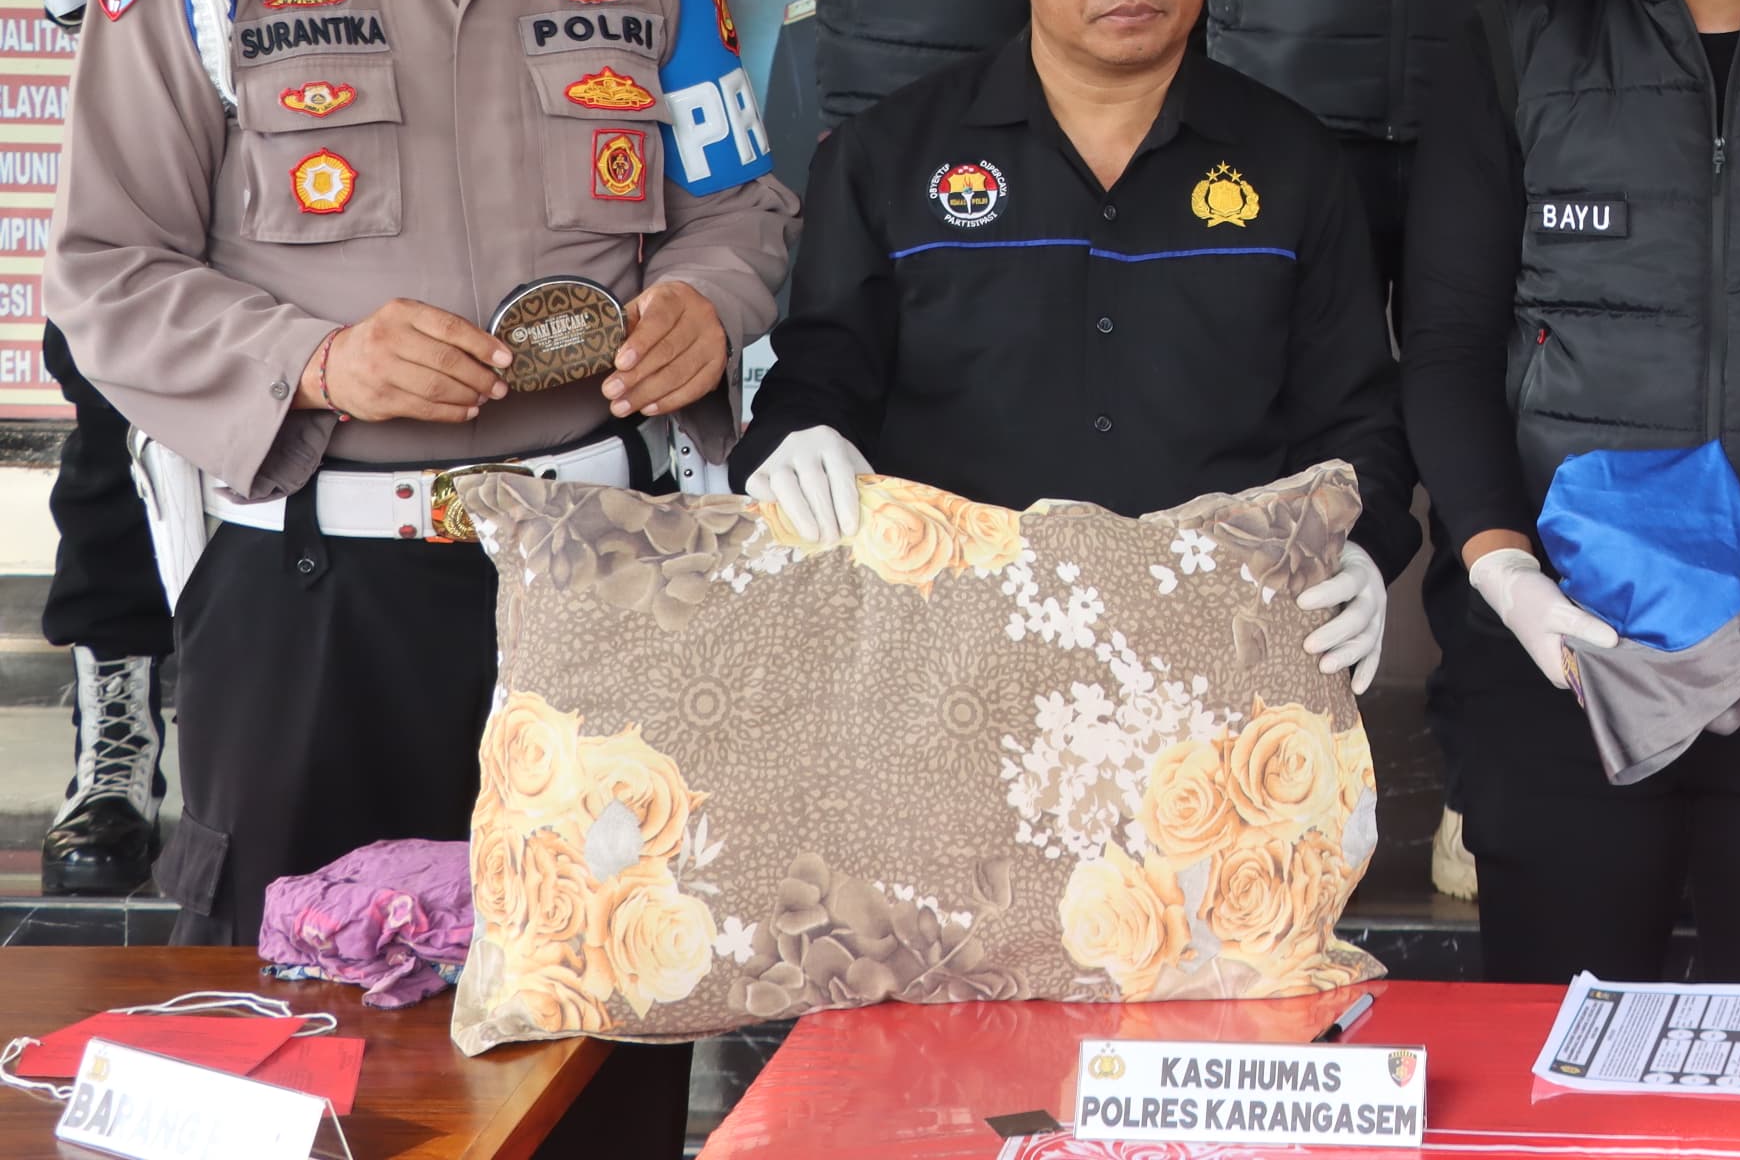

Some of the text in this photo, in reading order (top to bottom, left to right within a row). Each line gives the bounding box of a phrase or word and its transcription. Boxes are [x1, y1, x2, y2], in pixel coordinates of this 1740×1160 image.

[239, 15, 387, 60] SURANTIKA
[533, 13, 653, 50] POLRI
[1542, 203, 1611, 231] BAYU
[1160, 1056, 1342, 1093] KASI HUMAS
[1080, 1095, 1418, 1136] POLRES KARANGASEM
